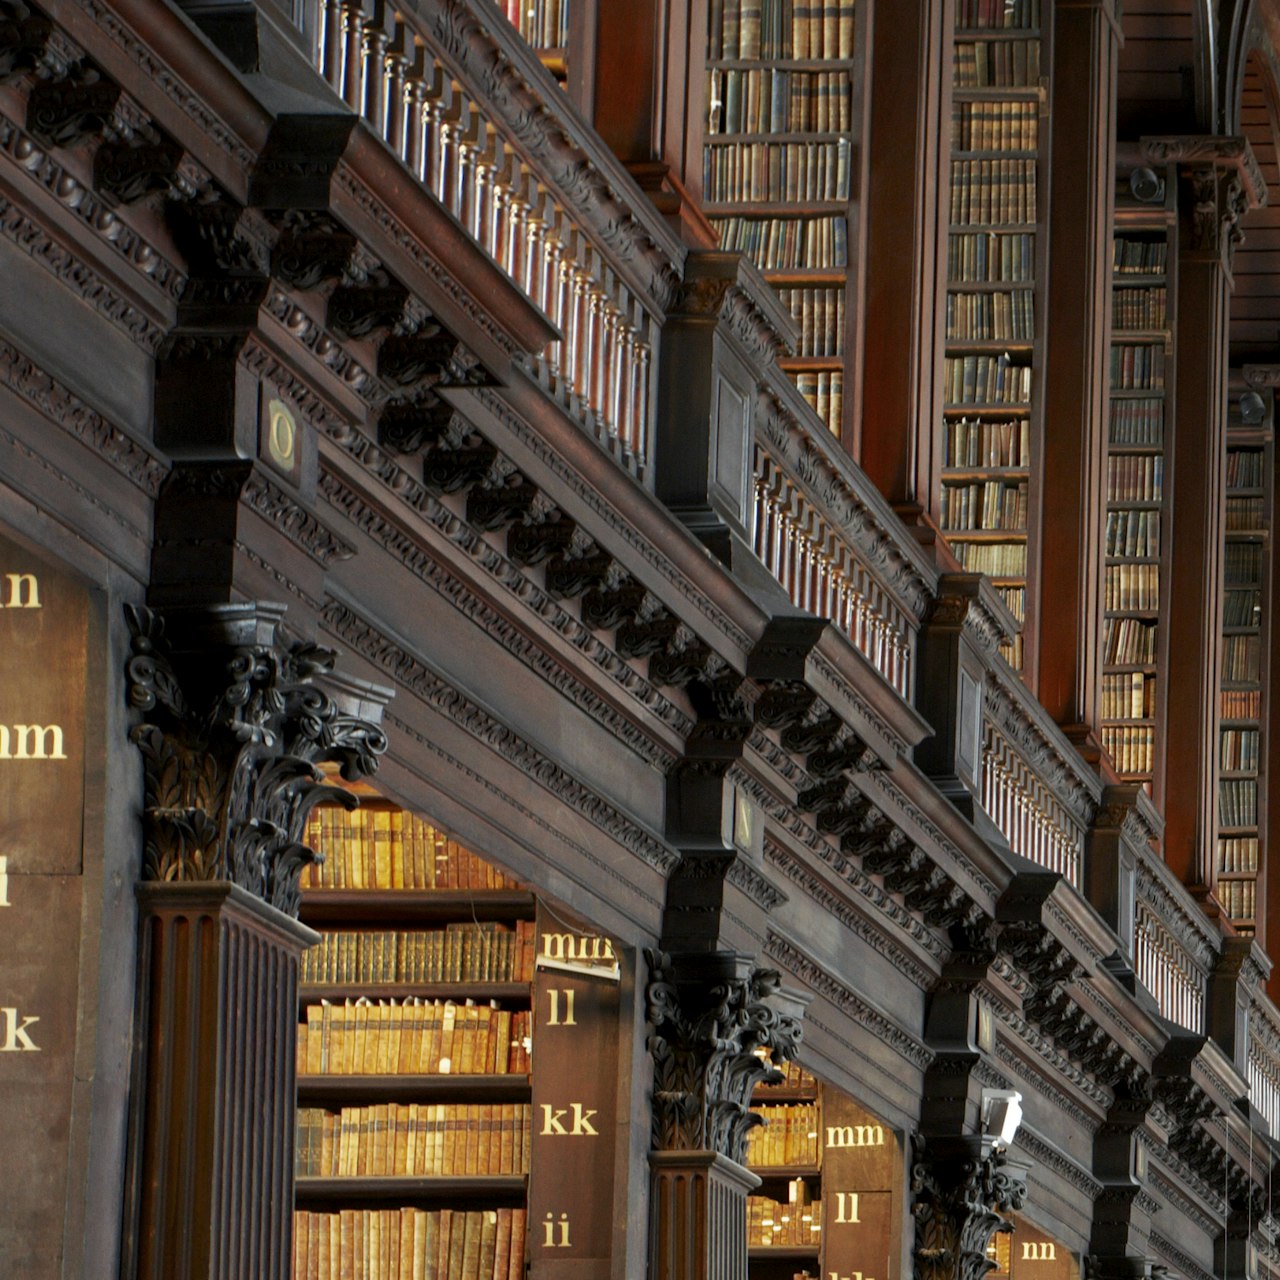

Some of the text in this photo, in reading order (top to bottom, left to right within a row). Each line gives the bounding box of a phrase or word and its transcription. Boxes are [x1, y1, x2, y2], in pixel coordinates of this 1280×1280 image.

[0, 574, 42, 609] n
[546, 989, 577, 1026] ll
[539, 1103, 599, 1136] kk
[826, 1125, 884, 1148] mm
[834, 1192, 861, 1223] ll
[542, 1212, 572, 1247] ii
[1021, 1240, 1057, 1261] nn
